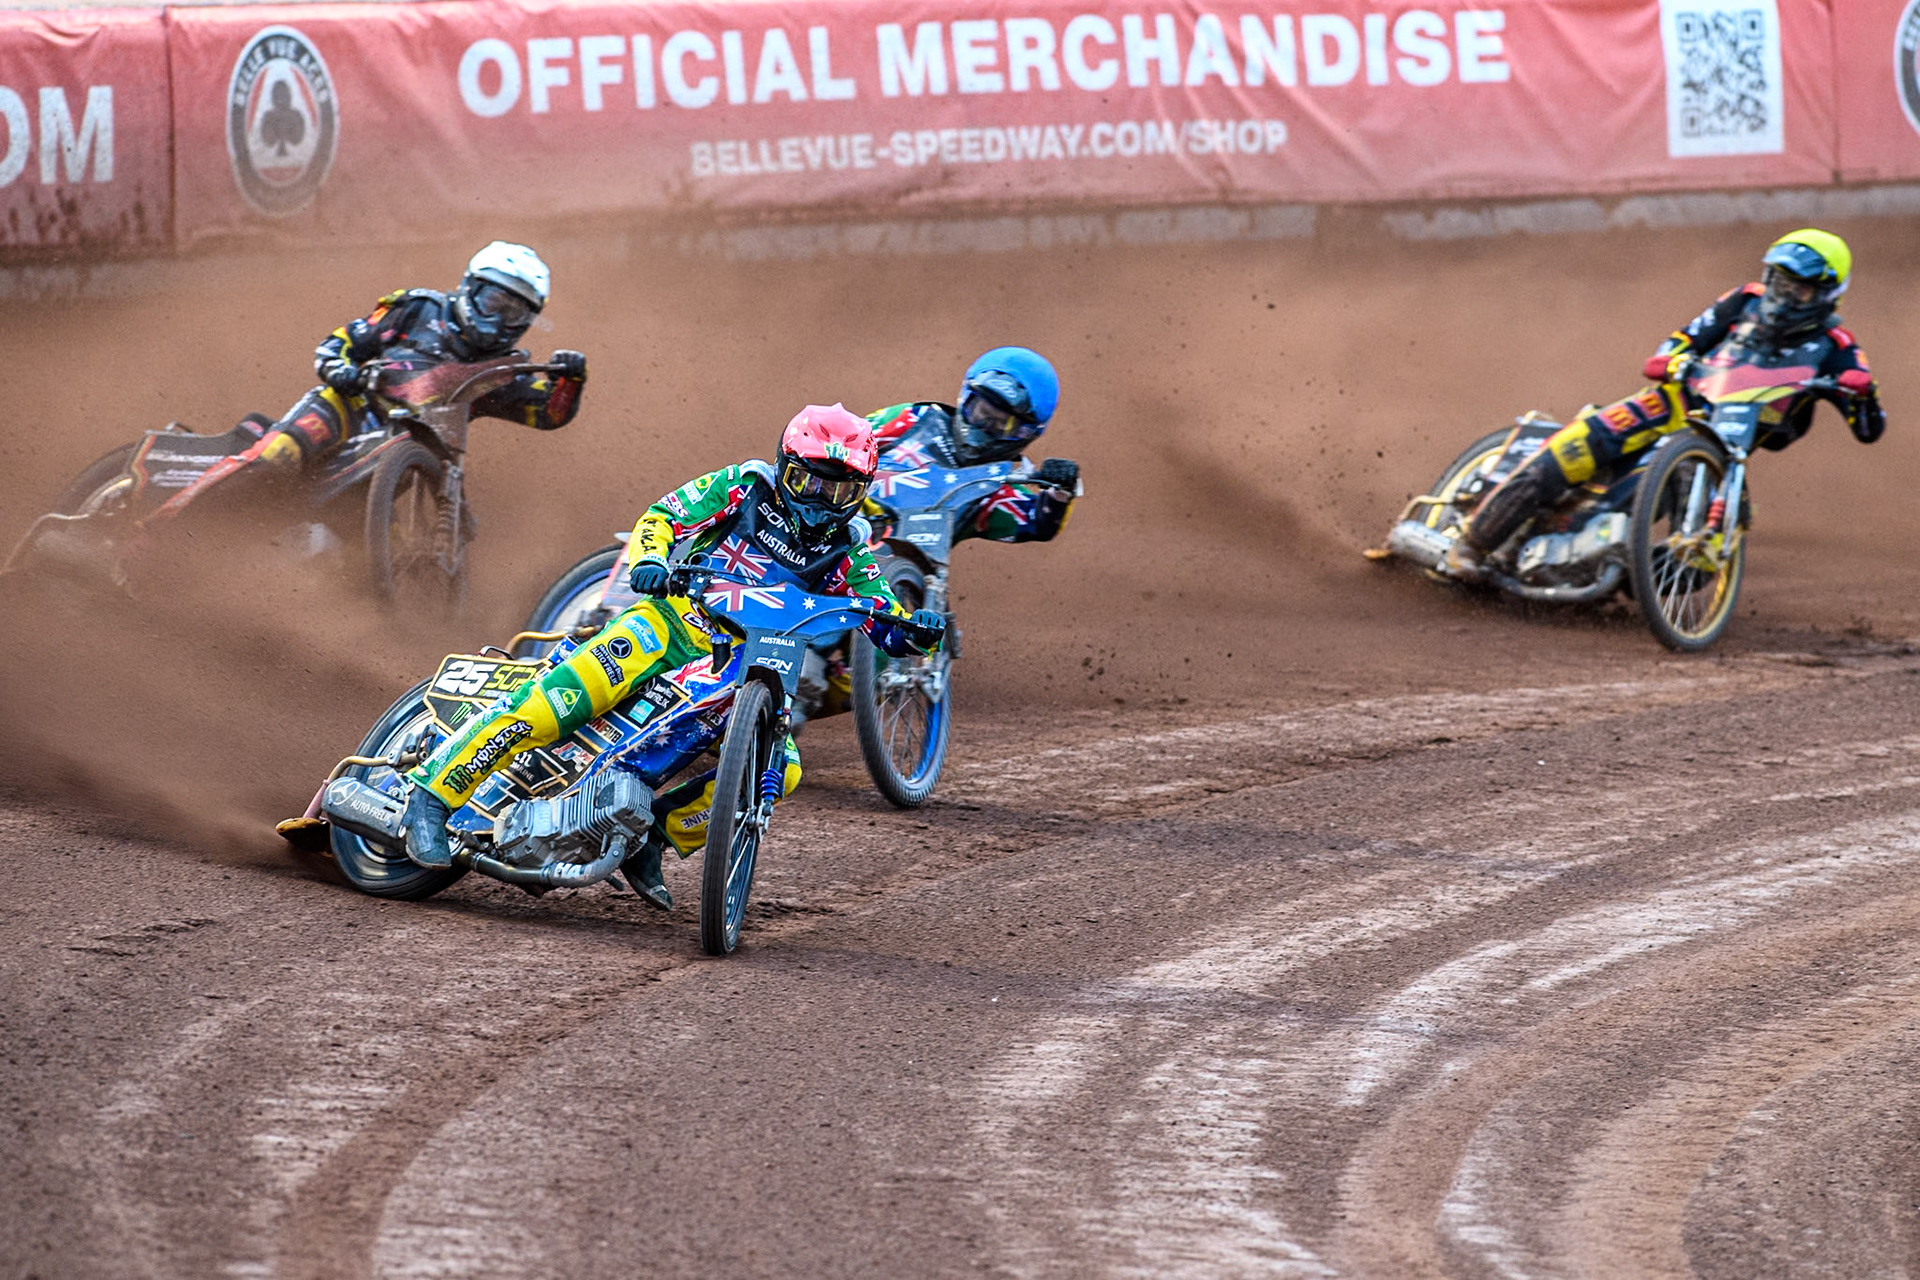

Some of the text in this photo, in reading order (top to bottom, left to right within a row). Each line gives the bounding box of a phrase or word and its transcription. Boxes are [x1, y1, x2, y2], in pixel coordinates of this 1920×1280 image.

[457, 9, 1511, 118] OFFICIAL MERCHANDISE
[689, 119, 1288, 177] BELLEVUE-SPEEDWAY.COM/SHOP
[756, 529, 807, 566] AUSTRALIA
[591, 647, 607, 663] AUTO
[759, 636, 796, 648] AUSTRALIA
[435, 660, 498, 696] 25
[466, 721, 532, 774] MONSTER
